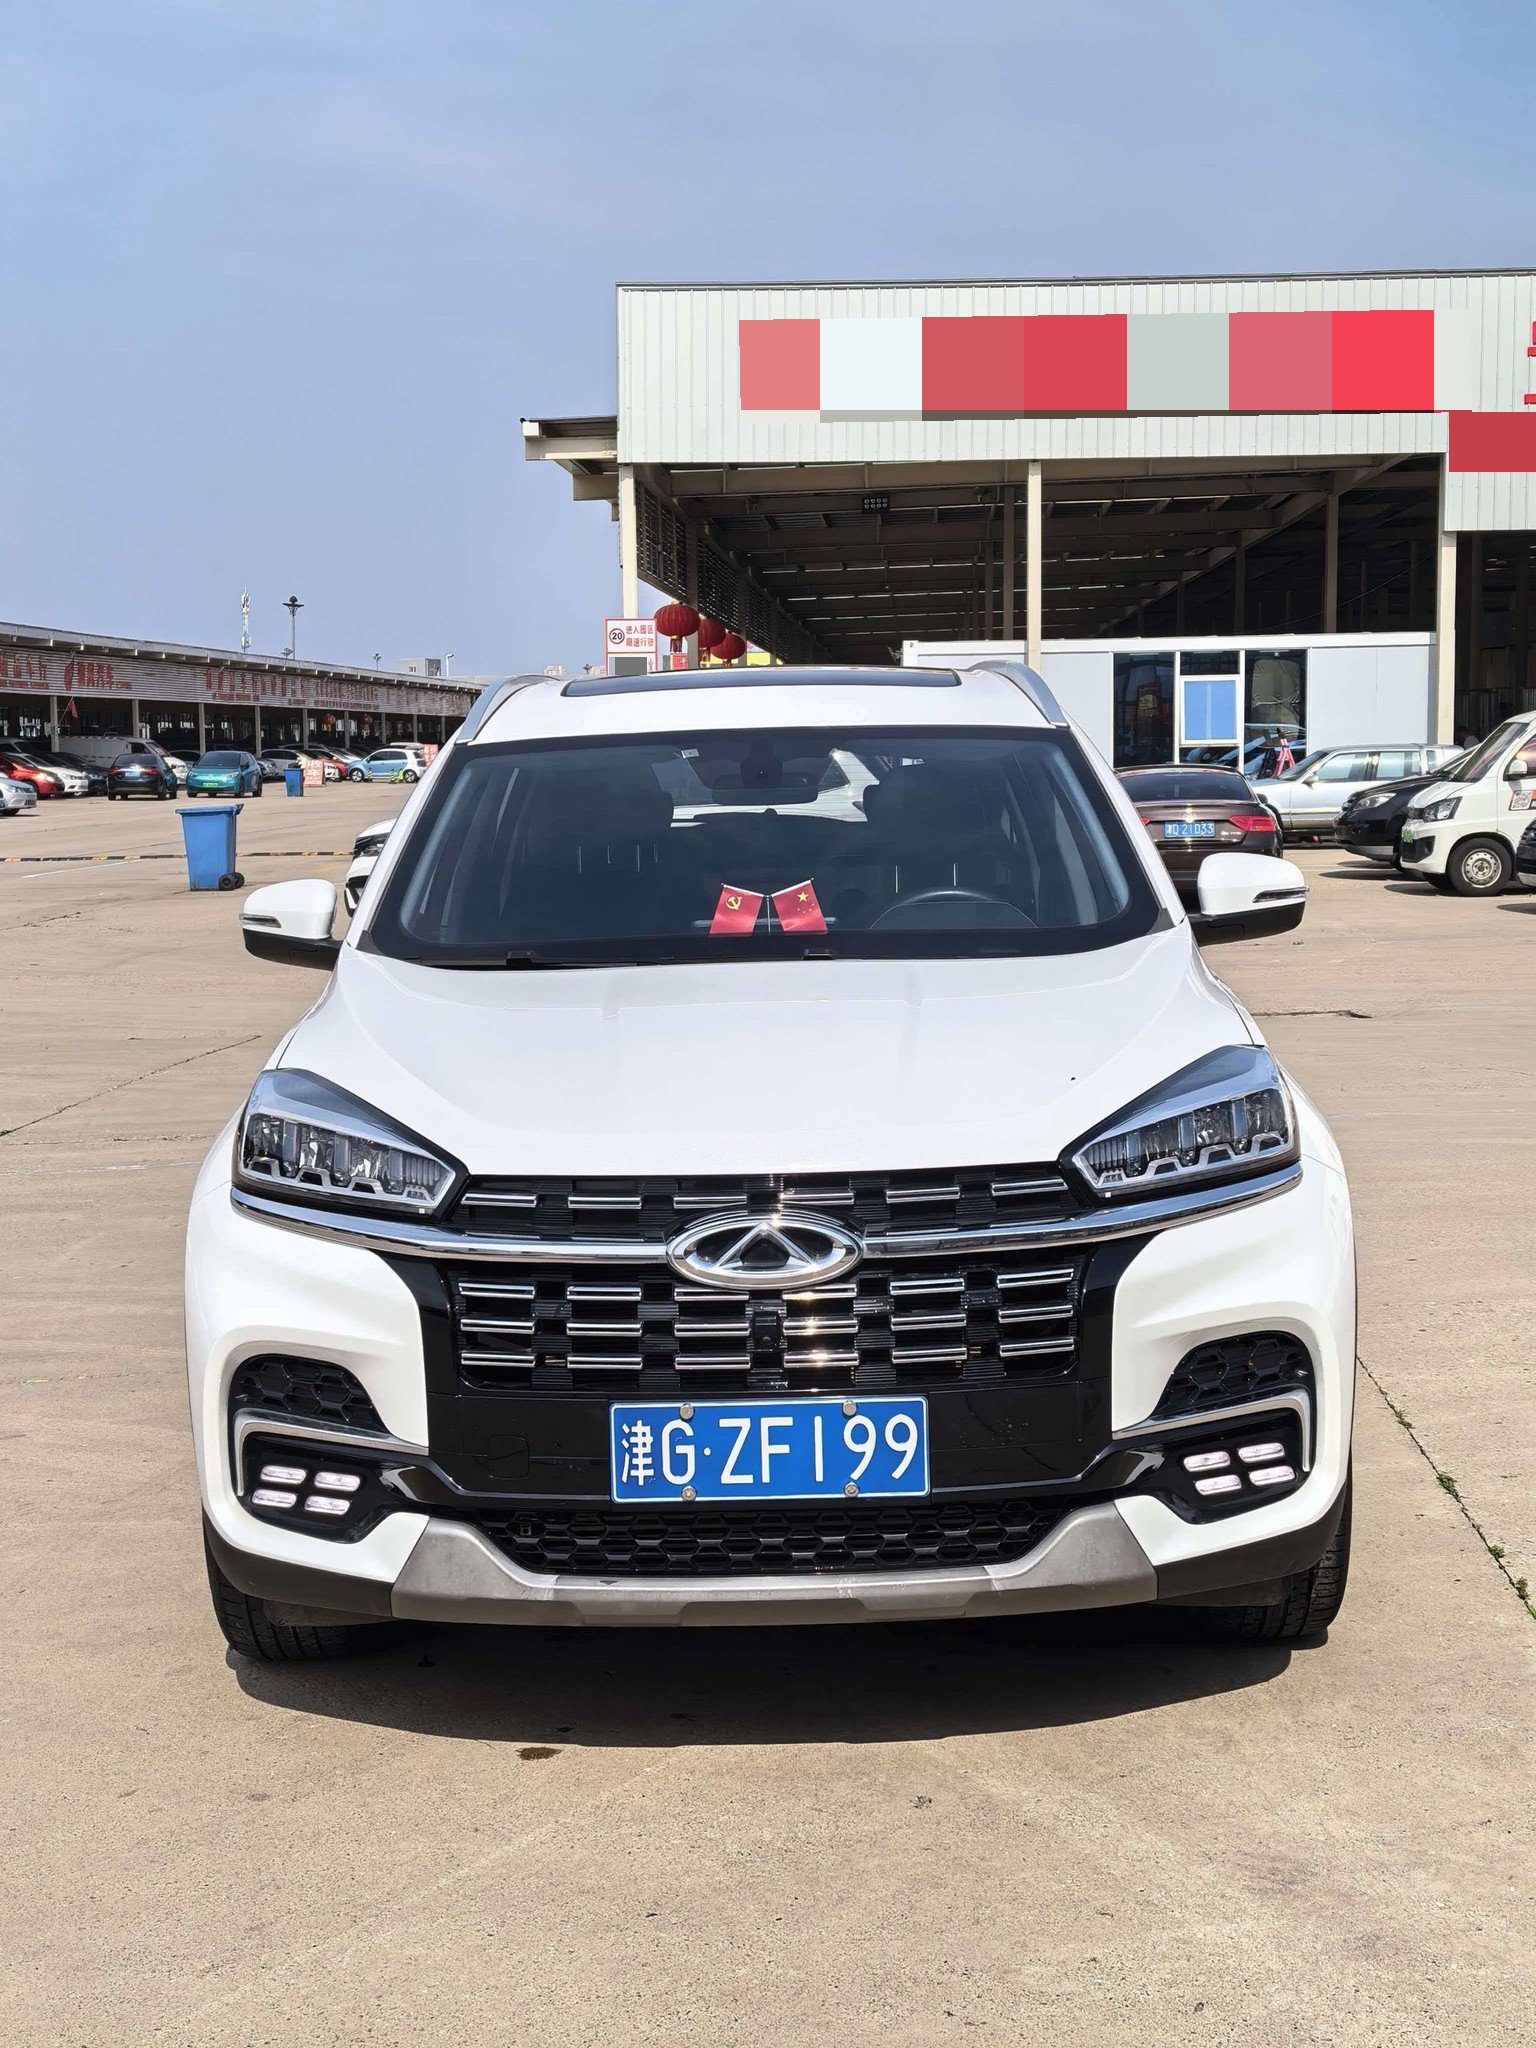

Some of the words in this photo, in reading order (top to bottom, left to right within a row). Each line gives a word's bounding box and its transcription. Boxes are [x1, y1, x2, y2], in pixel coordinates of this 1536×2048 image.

[626, 625, 654, 634] 进入园区
[612, 632, 623, 640] 20
[621, 1413, 918, 1486] 津G·ZF199
